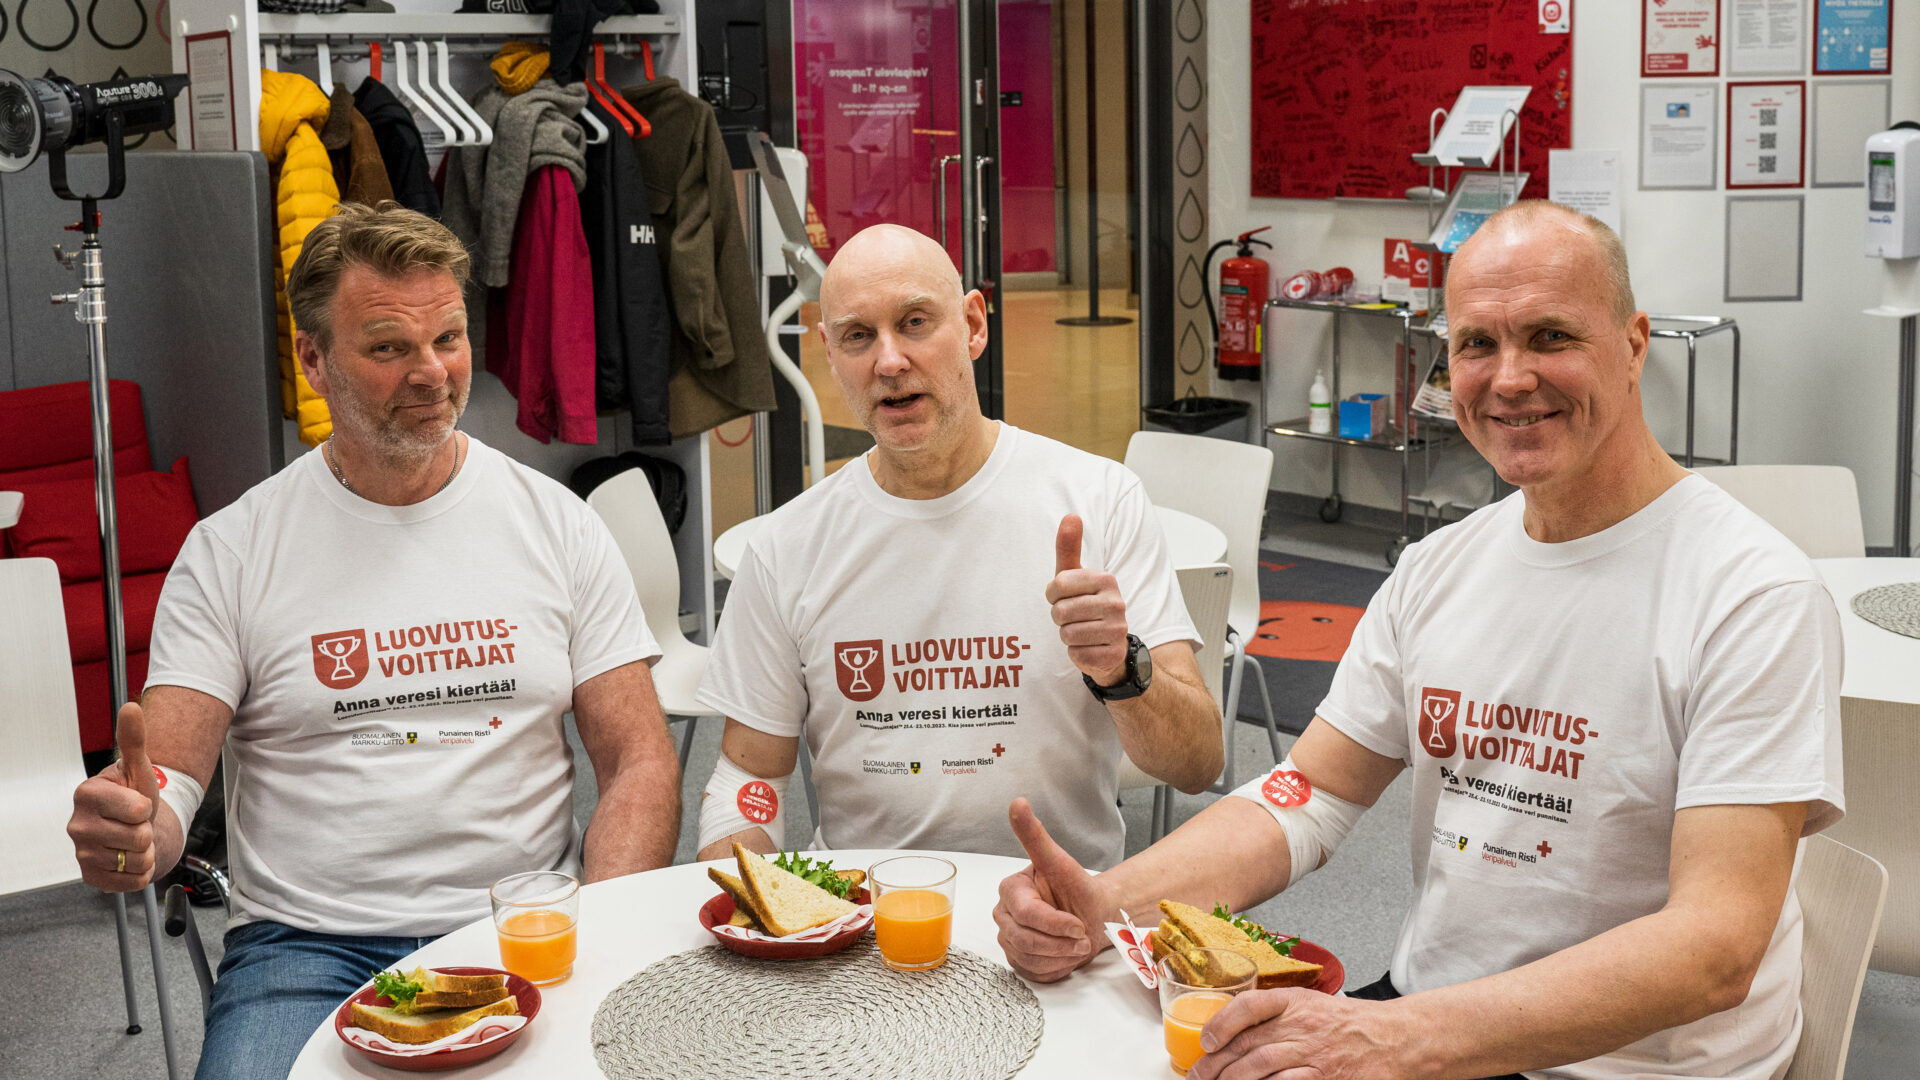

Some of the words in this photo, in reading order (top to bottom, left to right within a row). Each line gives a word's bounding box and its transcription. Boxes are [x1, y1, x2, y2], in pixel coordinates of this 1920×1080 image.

[630, 225, 656, 244] HH
[374, 618, 518, 652] LUOVUTUS-
[378, 643, 516, 678] VOITTAJAT
[891, 636, 1031, 667] LUOVUTUS-
[892, 664, 1024, 694] VOITTAJAT
[333, 698, 380, 714] Anna
[386, 687, 441, 706] veresi
[447, 679, 516, 698] kiertää!
[856, 710, 894, 723] Anna
[898, 706, 947, 720] veresi
[952, 704, 1018, 720] kiertää!
[1465, 700, 1599, 746] LUOVUTUS-
[351, 732, 402, 740] SUOMALAINEN
[438, 730, 474, 738] Punainen
[440, 737, 475, 746] Veripalvelu
[862, 760, 906, 768] SUOMALAINEN
[942, 759, 976, 767] Punainen
[977, 758, 994, 766] Risti
[1462, 733, 1585, 780] VOITTAJAT
[863, 766, 908, 775] MARKKU-LIITTO
[942, 767, 977, 776] Veripalvelu
[1465, 776, 1508, 798] veresi
[1507, 784, 1573, 814] kiertää!
[1524, 808, 1536, 816] veri
[1482, 851, 1517, 868] Veripalvelu
[1483, 842, 1517, 859] Punainen
[1518, 851, 1537, 864] Risti
